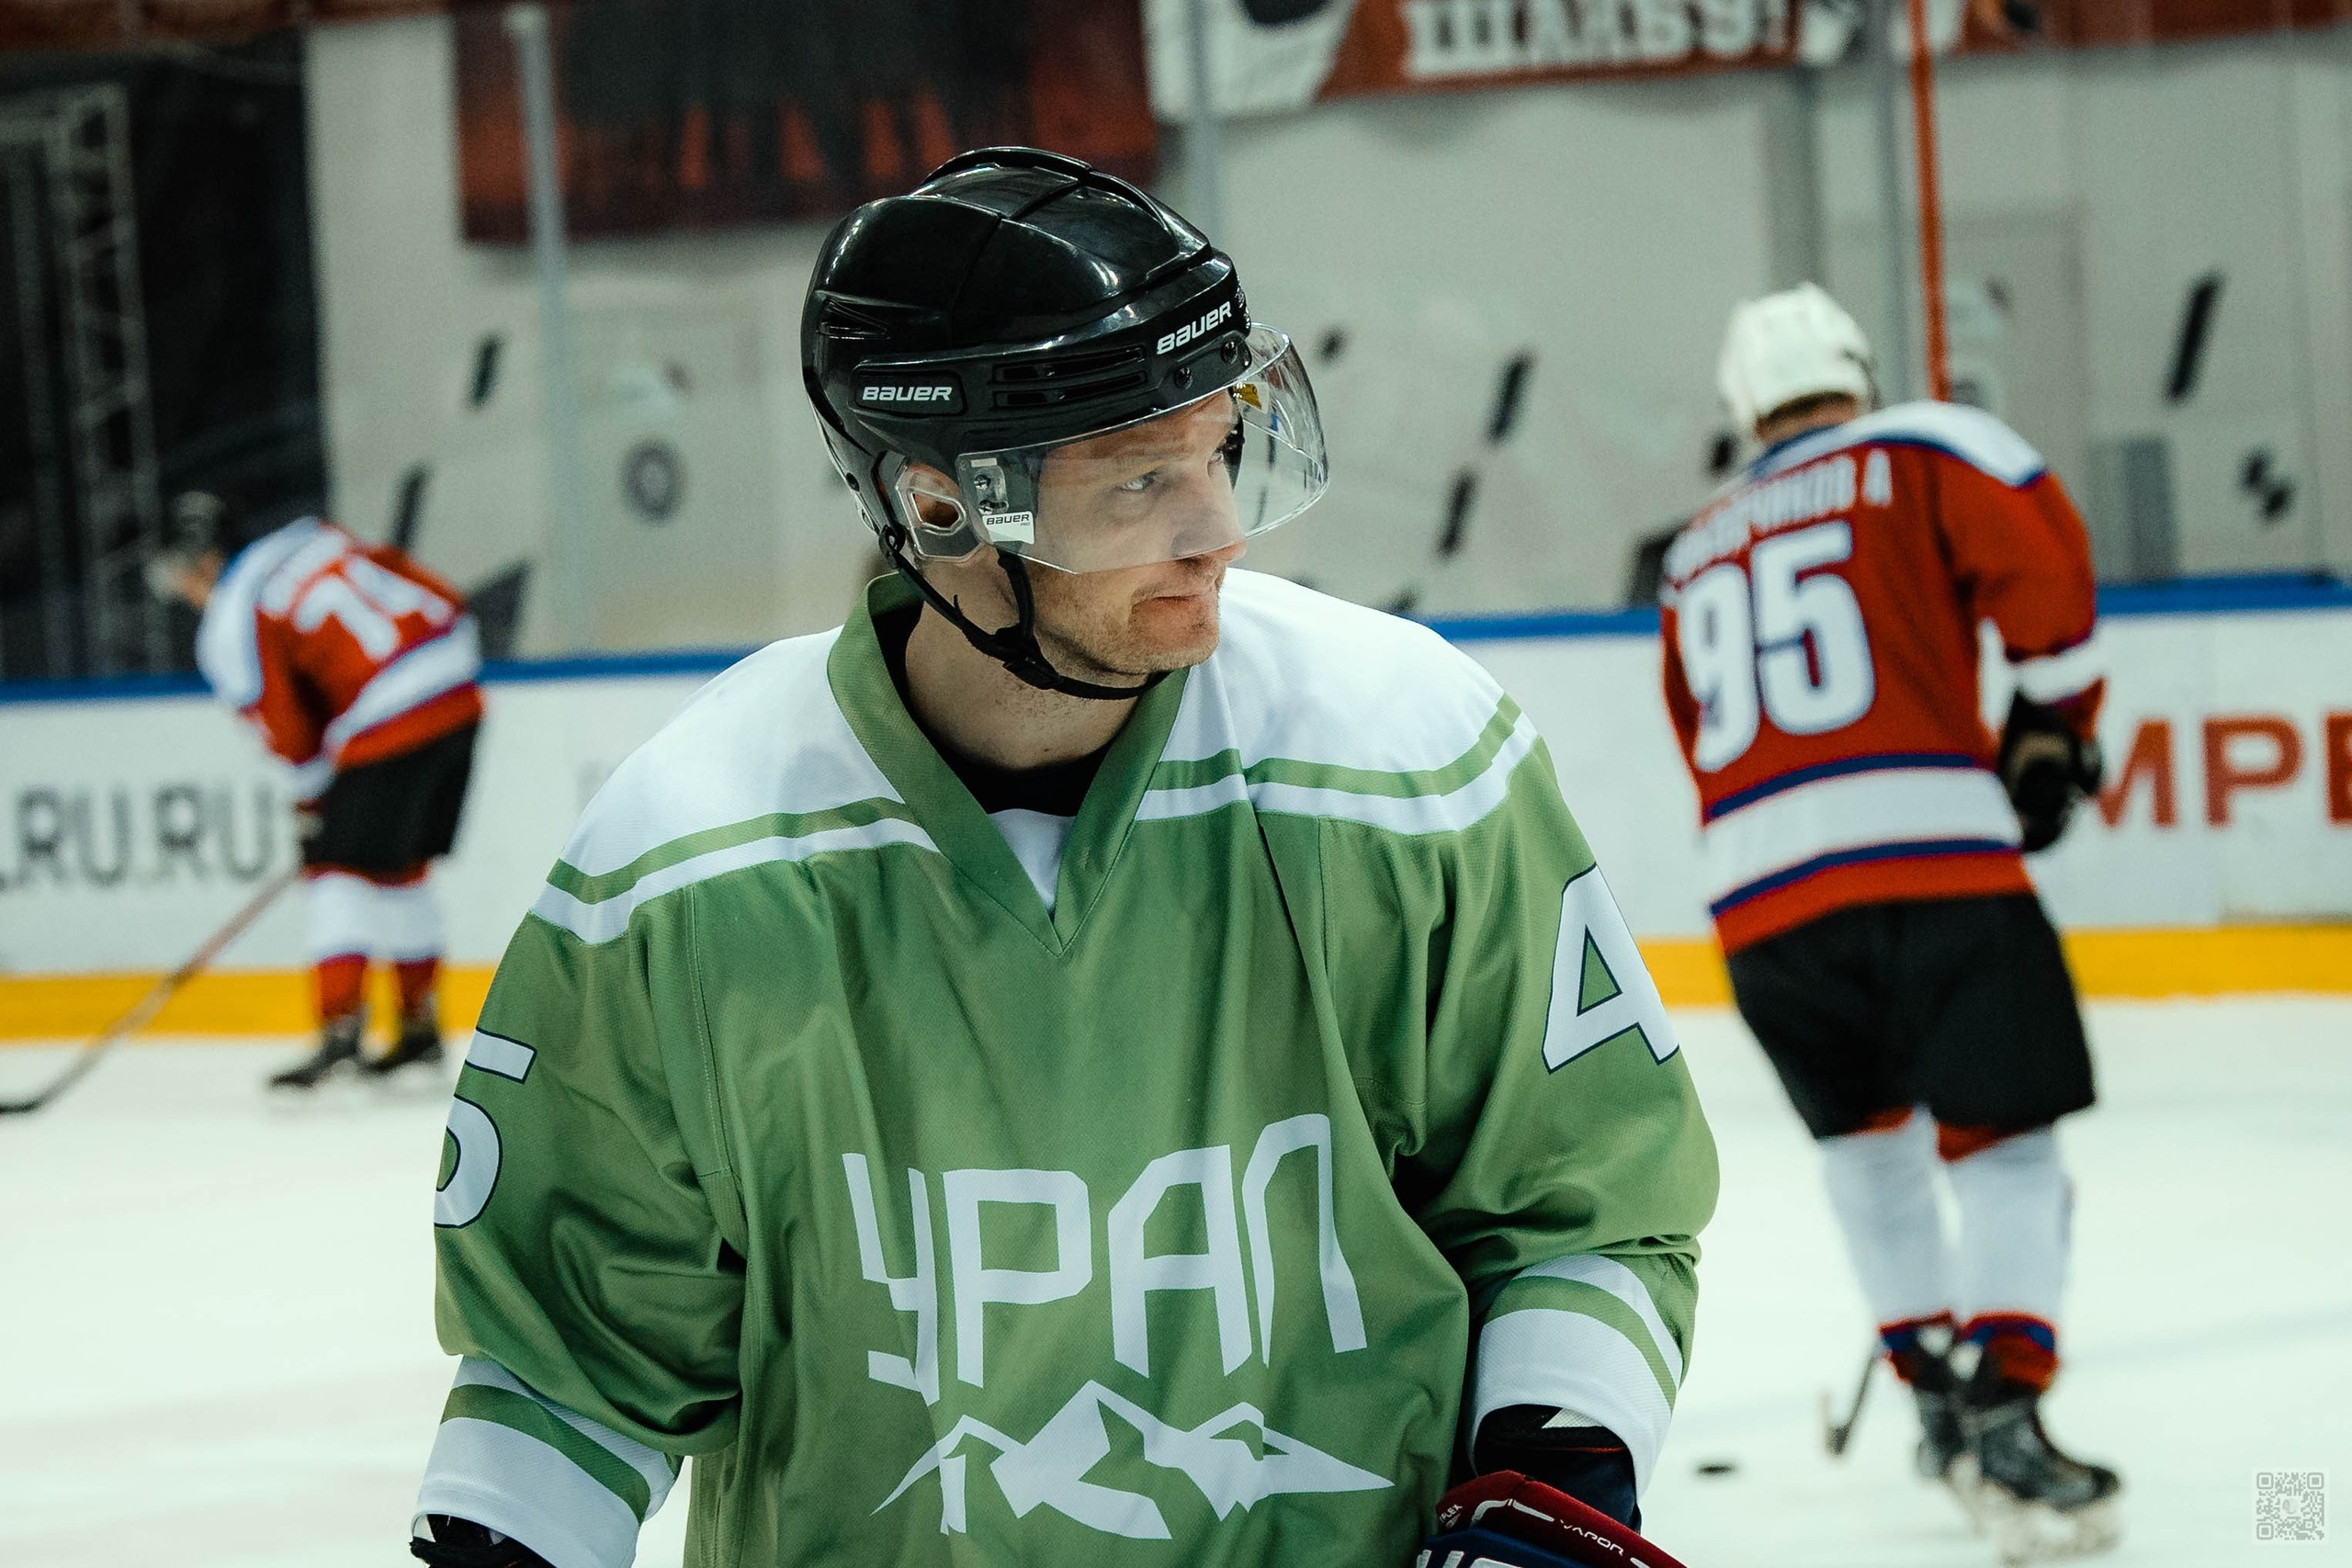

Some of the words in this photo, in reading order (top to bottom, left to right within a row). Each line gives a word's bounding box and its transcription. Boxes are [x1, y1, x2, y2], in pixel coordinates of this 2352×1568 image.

[1678, 518, 1876, 773] 95
[1542, 861, 1680, 1075] 4
[434, 1026, 537, 1229] 5
[841, 1113, 1368, 1407] УРАЛ
[1560, 1518, 1624, 1556] VAPOR
